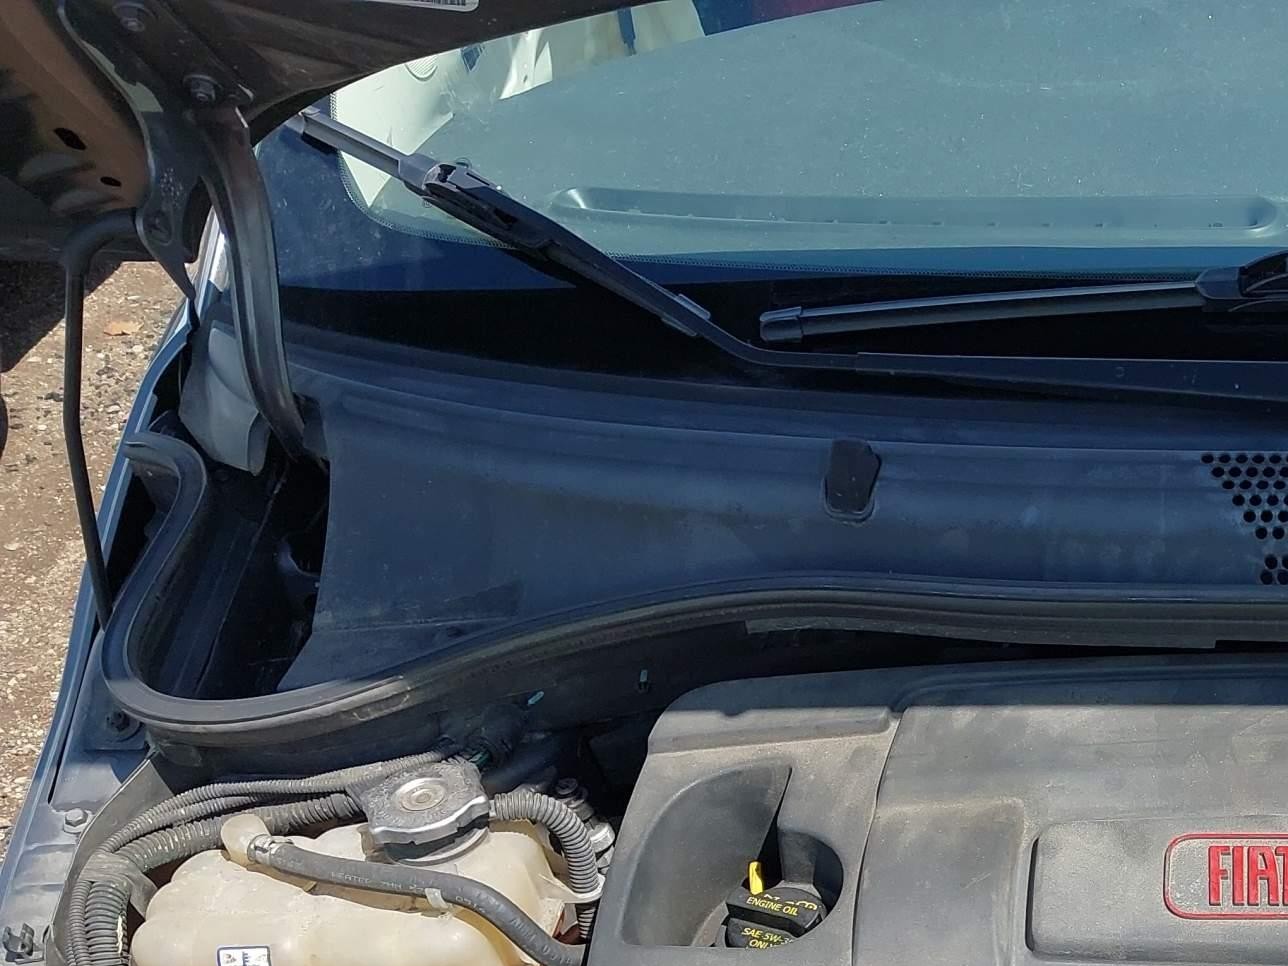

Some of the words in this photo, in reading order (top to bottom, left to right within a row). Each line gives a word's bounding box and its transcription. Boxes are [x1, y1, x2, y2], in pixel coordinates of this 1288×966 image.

[746, 896, 782, 912] ENGINE
[782, 906, 799, 916] OIL
[741, 927, 763, 938] SAE
